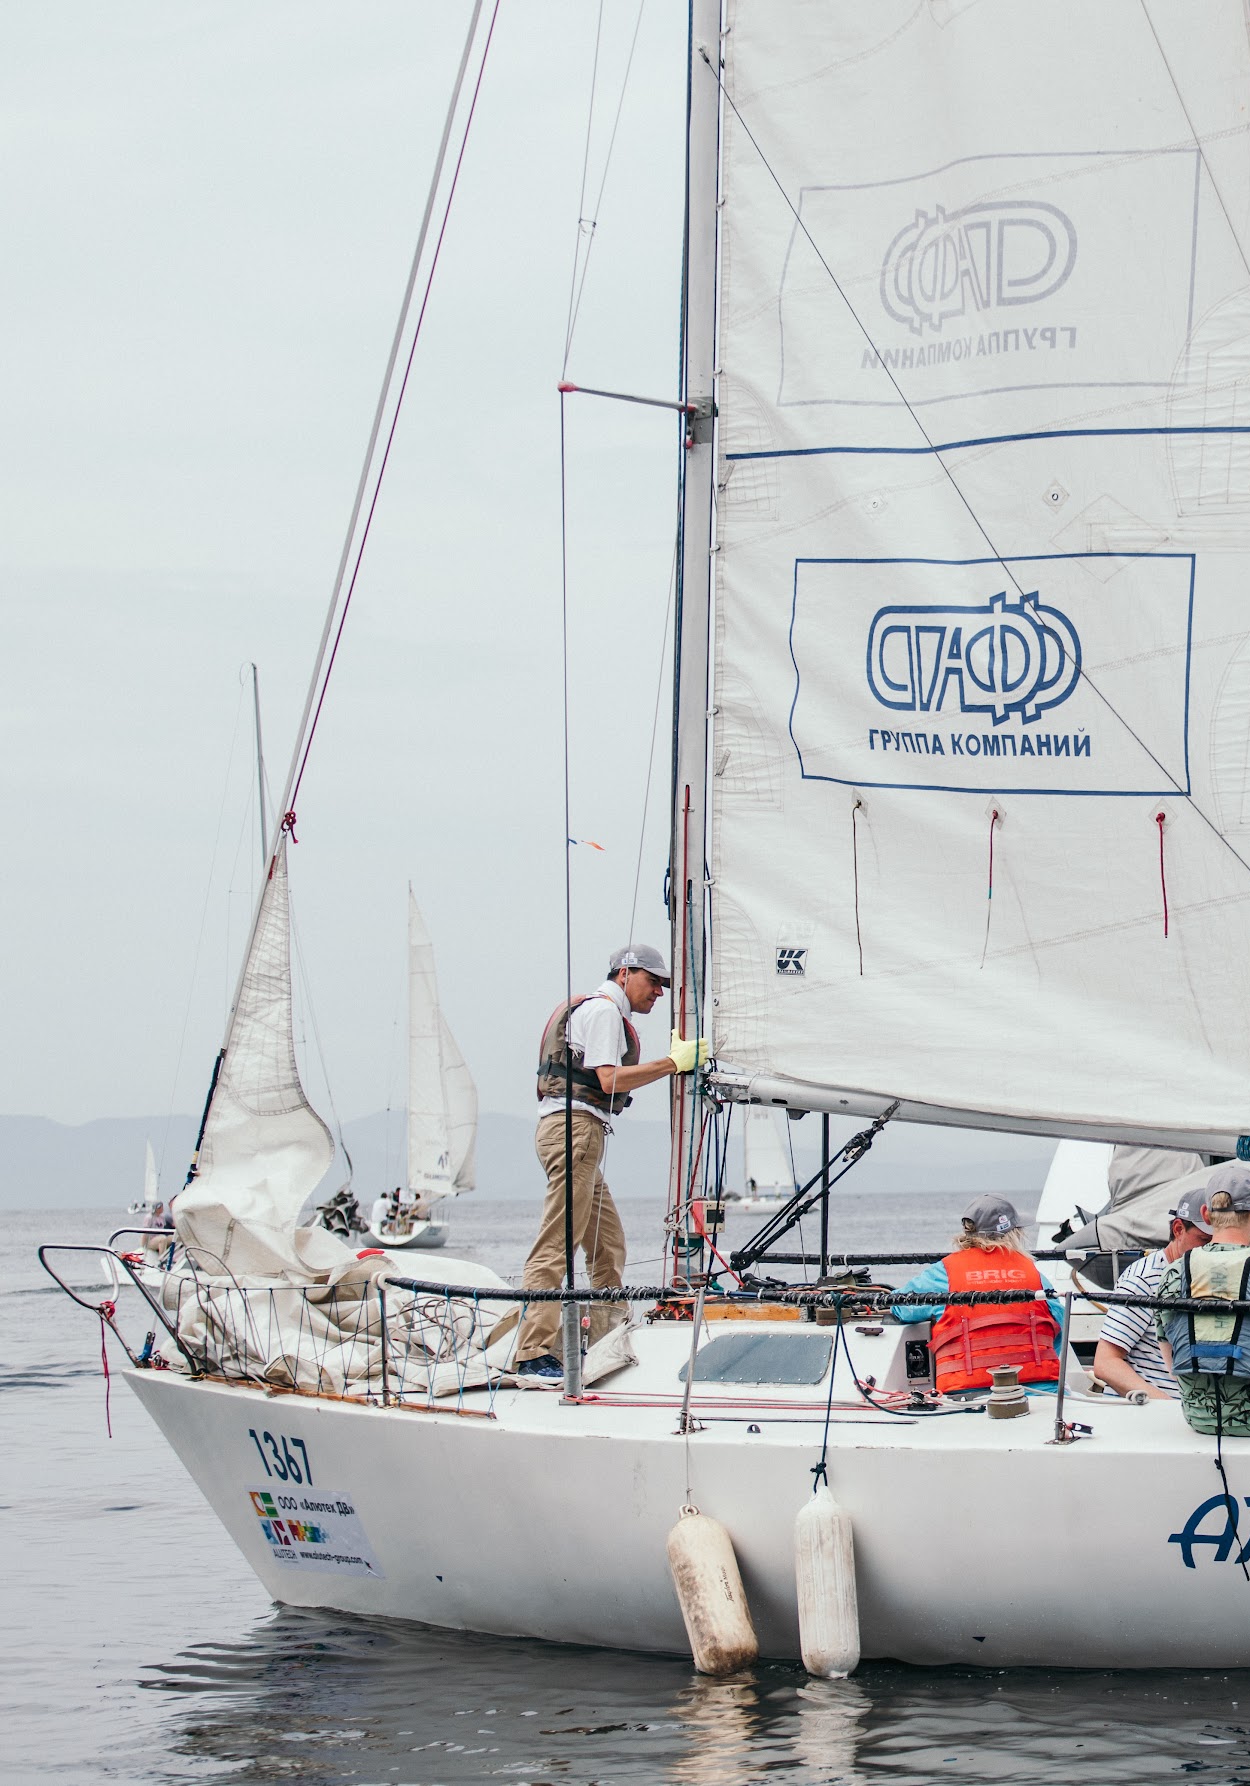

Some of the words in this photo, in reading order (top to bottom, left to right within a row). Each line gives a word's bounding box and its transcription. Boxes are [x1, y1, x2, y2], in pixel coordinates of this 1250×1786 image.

[868, 728, 945, 756] ГРУППА
[951, 727, 1092, 758] КОМПАНИЙ
[965, 1269, 1027, 1280] BRIG
[249, 1428, 313, 1486] 1367
[277, 1496, 298, 1510] ООО
